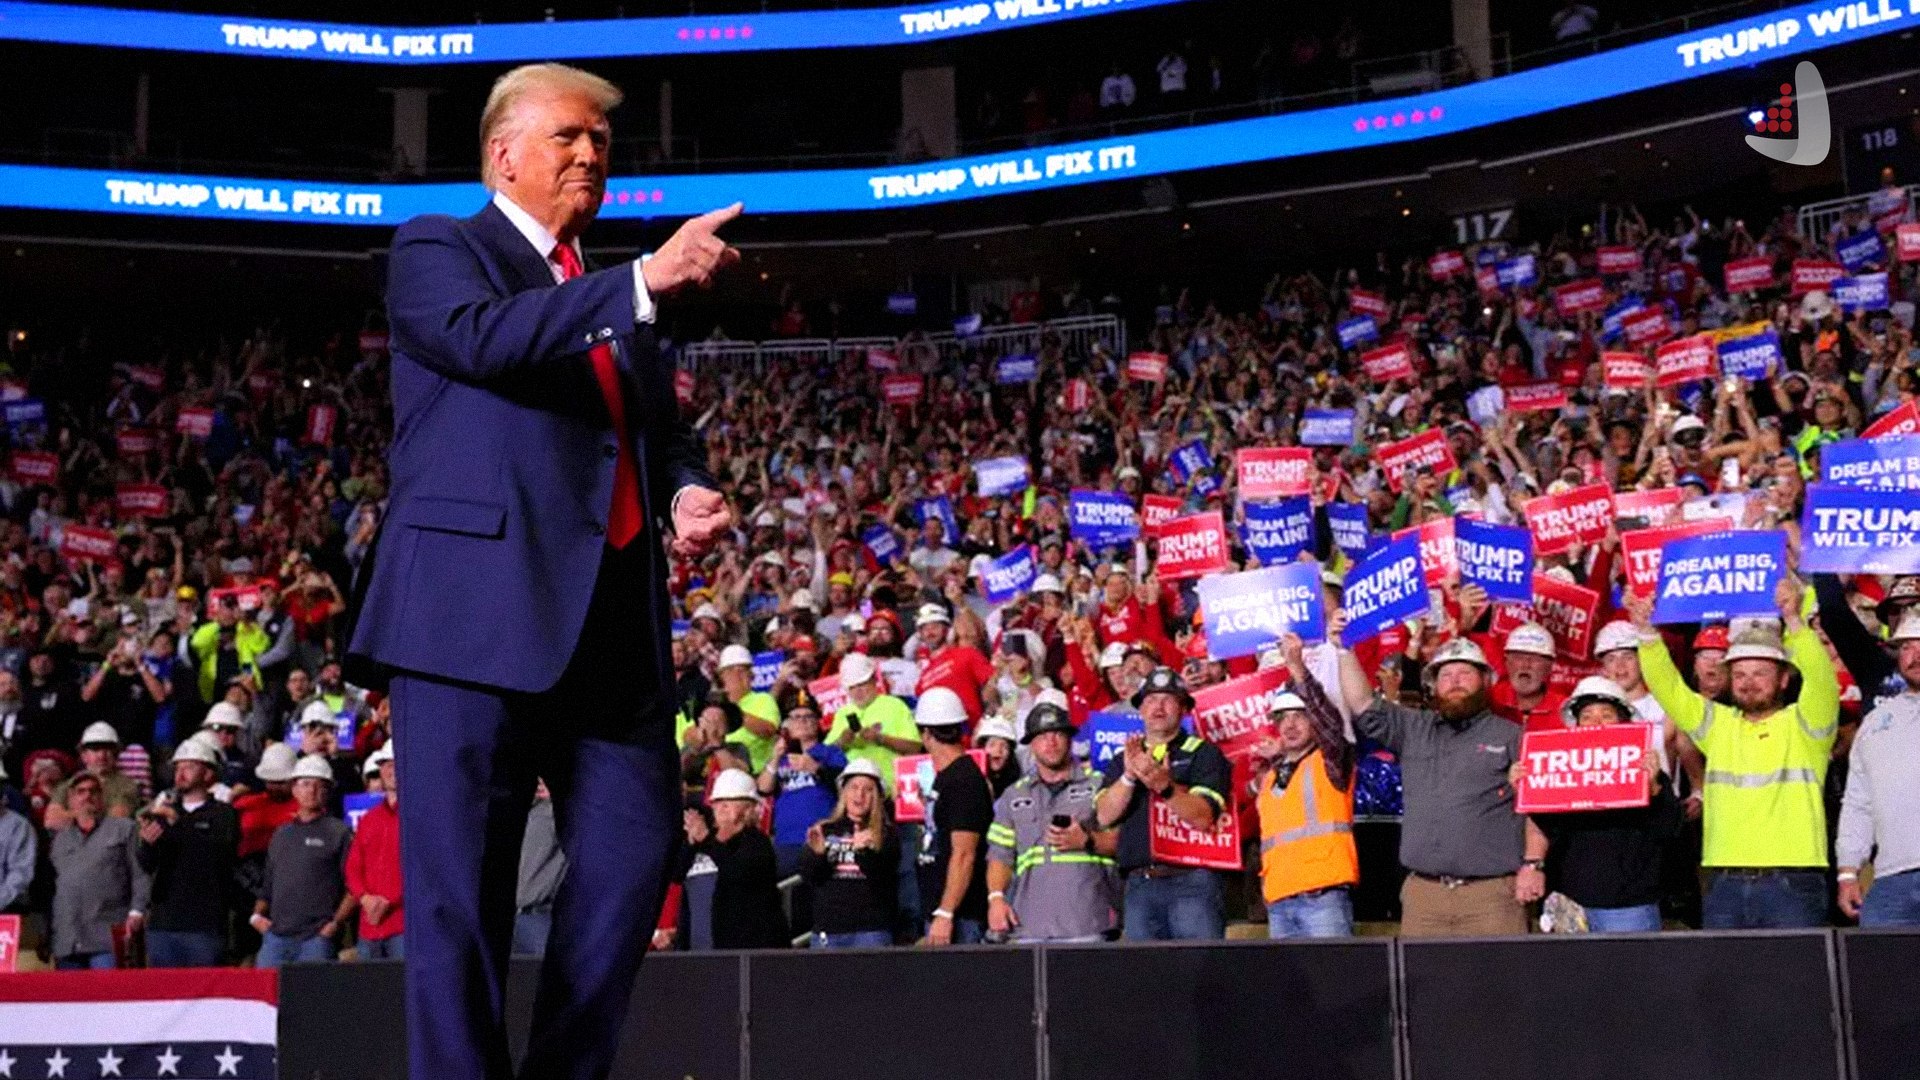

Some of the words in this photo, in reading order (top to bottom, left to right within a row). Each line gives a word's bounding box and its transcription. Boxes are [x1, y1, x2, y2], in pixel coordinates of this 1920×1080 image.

[900, 4, 991, 34] TRUMP
[993, 0, 1061, 20] WILL
[221, 23, 317, 49] TRUMP
[320, 31, 389, 55] WILL
[393, 34, 436, 56] FIX
[440, 33, 473, 54] IT!
[1676, 18, 1800, 67] TRUMP
[1806, 0, 1902, 37] WILL
[1863, 127, 1898, 150] 118
[868, 168, 966, 199] TRUMP
[970, 158, 1042, 187] WILL
[1045, 150, 1094, 178] FIX
[1098, 145, 1136, 171] IT!
[105, 180, 210, 208] TRUMP
[214, 186, 288, 212] WILL
[292, 190, 341, 214] FIX
[345, 193, 382, 216] IT!
[1454, 209, 1514, 244] 117
[1243, 459, 1308, 477] TRUMP
[1829, 457, 1901, 480] DREAM
[1075, 502, 1134, 518] TRUMP
[1146, 505, 1178, 520] TRU
[1532, 498, 1610, 531] TRUMP
[1813, 508, 1920, 532] TRUM
[1159, 530, 1219, 554] TRUMP
[1813, 531, 1871, 548] WILL
[1876, 531, 1915, 548] FIX
[1455, 538, 1525, 569] TRUMP
[1665, 555, 1730, 577] DREAM
[1734, 552, 1777, 571] BIG,
[1345, 556, 1417, 607] TRUMP
[1477, 566, 1503, 582] FIX
[1507, 570, 1524, 584] IT
[1662, 571, 1767, 599] AGAIN!
[1278, 585, 1316, 602] BIG,
[1379, 586, 1404, 607] FIX
[1404, 577, 1419, 596] IT
[1216, 601, 1310, 636] AGAIN!
[1200, 687, 1280, 729] TRUM
[1095, 731, 1128, 745] DRE
[1206, 721, 1252, 742] WILL
[1527, 745, 1641, 774] TRUMP
[1528, 773, 1578, 789] WILL
[1582, 770, 1615, 787] FIX
[1620, 768, 1640, 784] IT
[1155, 801, 1232, 833] TRP
[1155, 824, 1187, 844] WILL
[1188, 830, 1215, 846] FIX
[1217, 833, 1233, 848] IT
